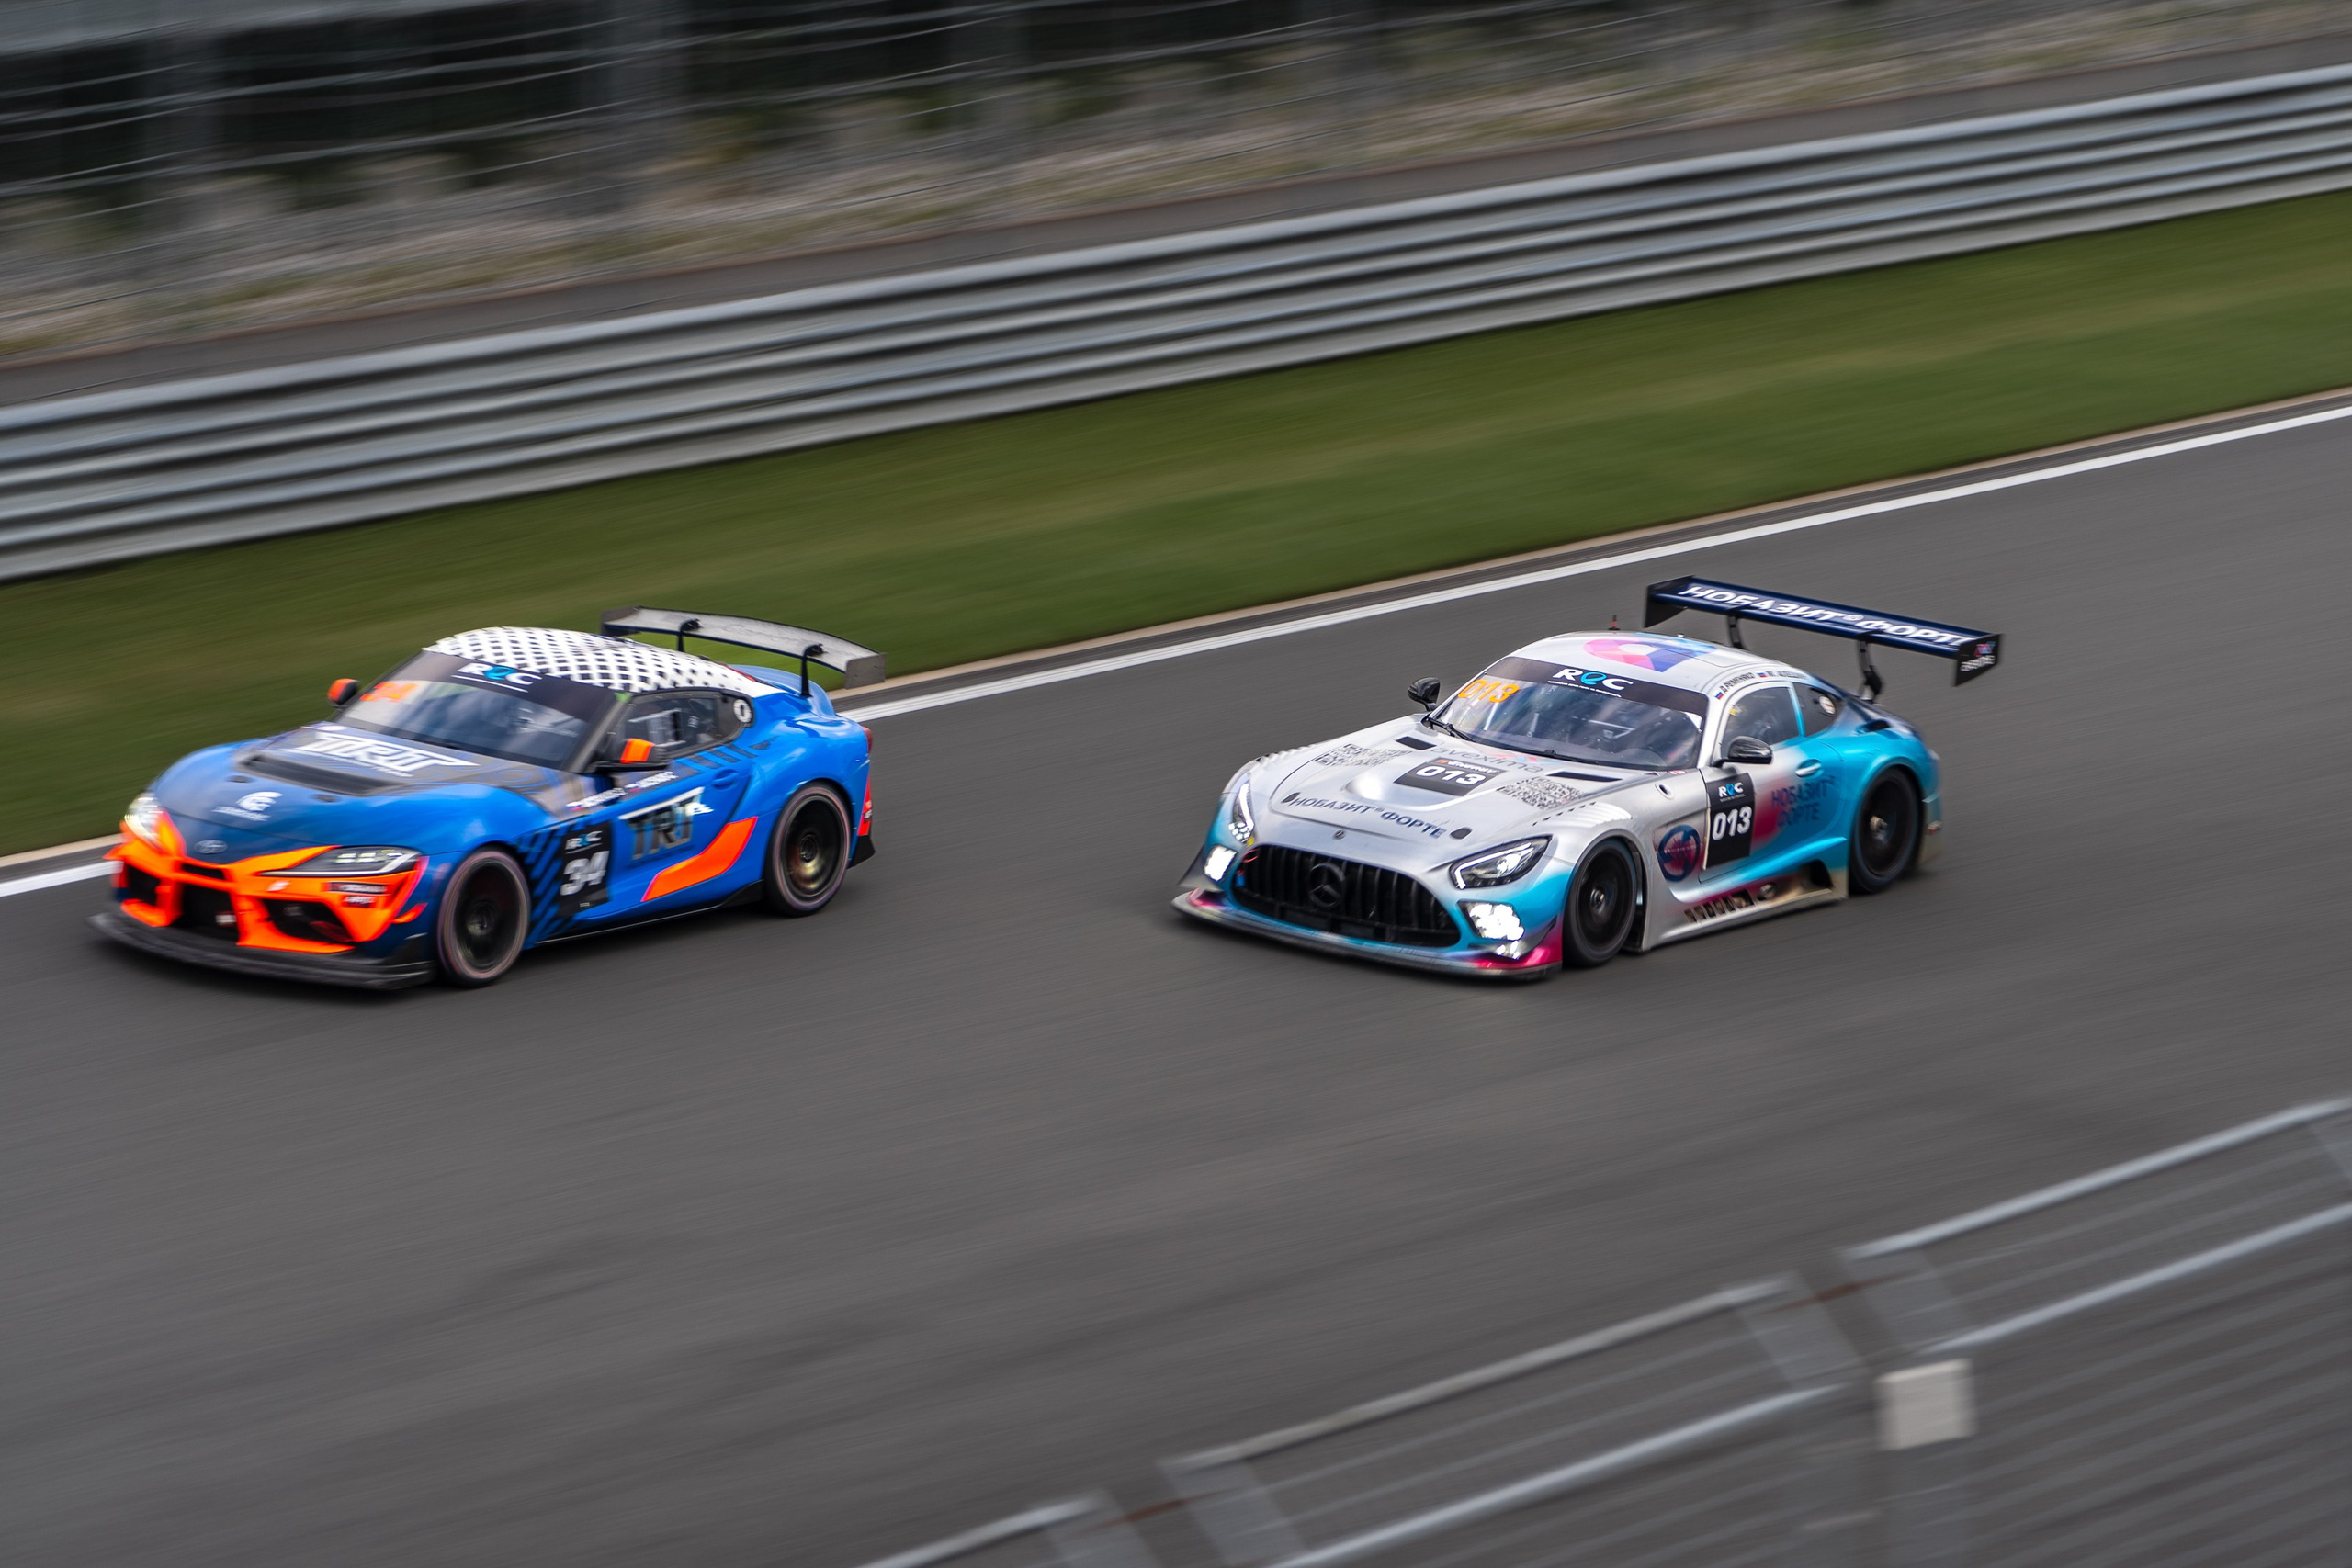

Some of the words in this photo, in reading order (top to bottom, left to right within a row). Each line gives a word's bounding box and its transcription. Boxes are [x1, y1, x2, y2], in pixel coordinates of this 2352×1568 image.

[1457, 679, 1520, 703] 013
[1416, 766, 1486, 785] 013
[1380, 810, 1448, 839] ФОРТЕ
[1712, 806, 1752, 841] 013
[560, 851, 610, 897] 34
